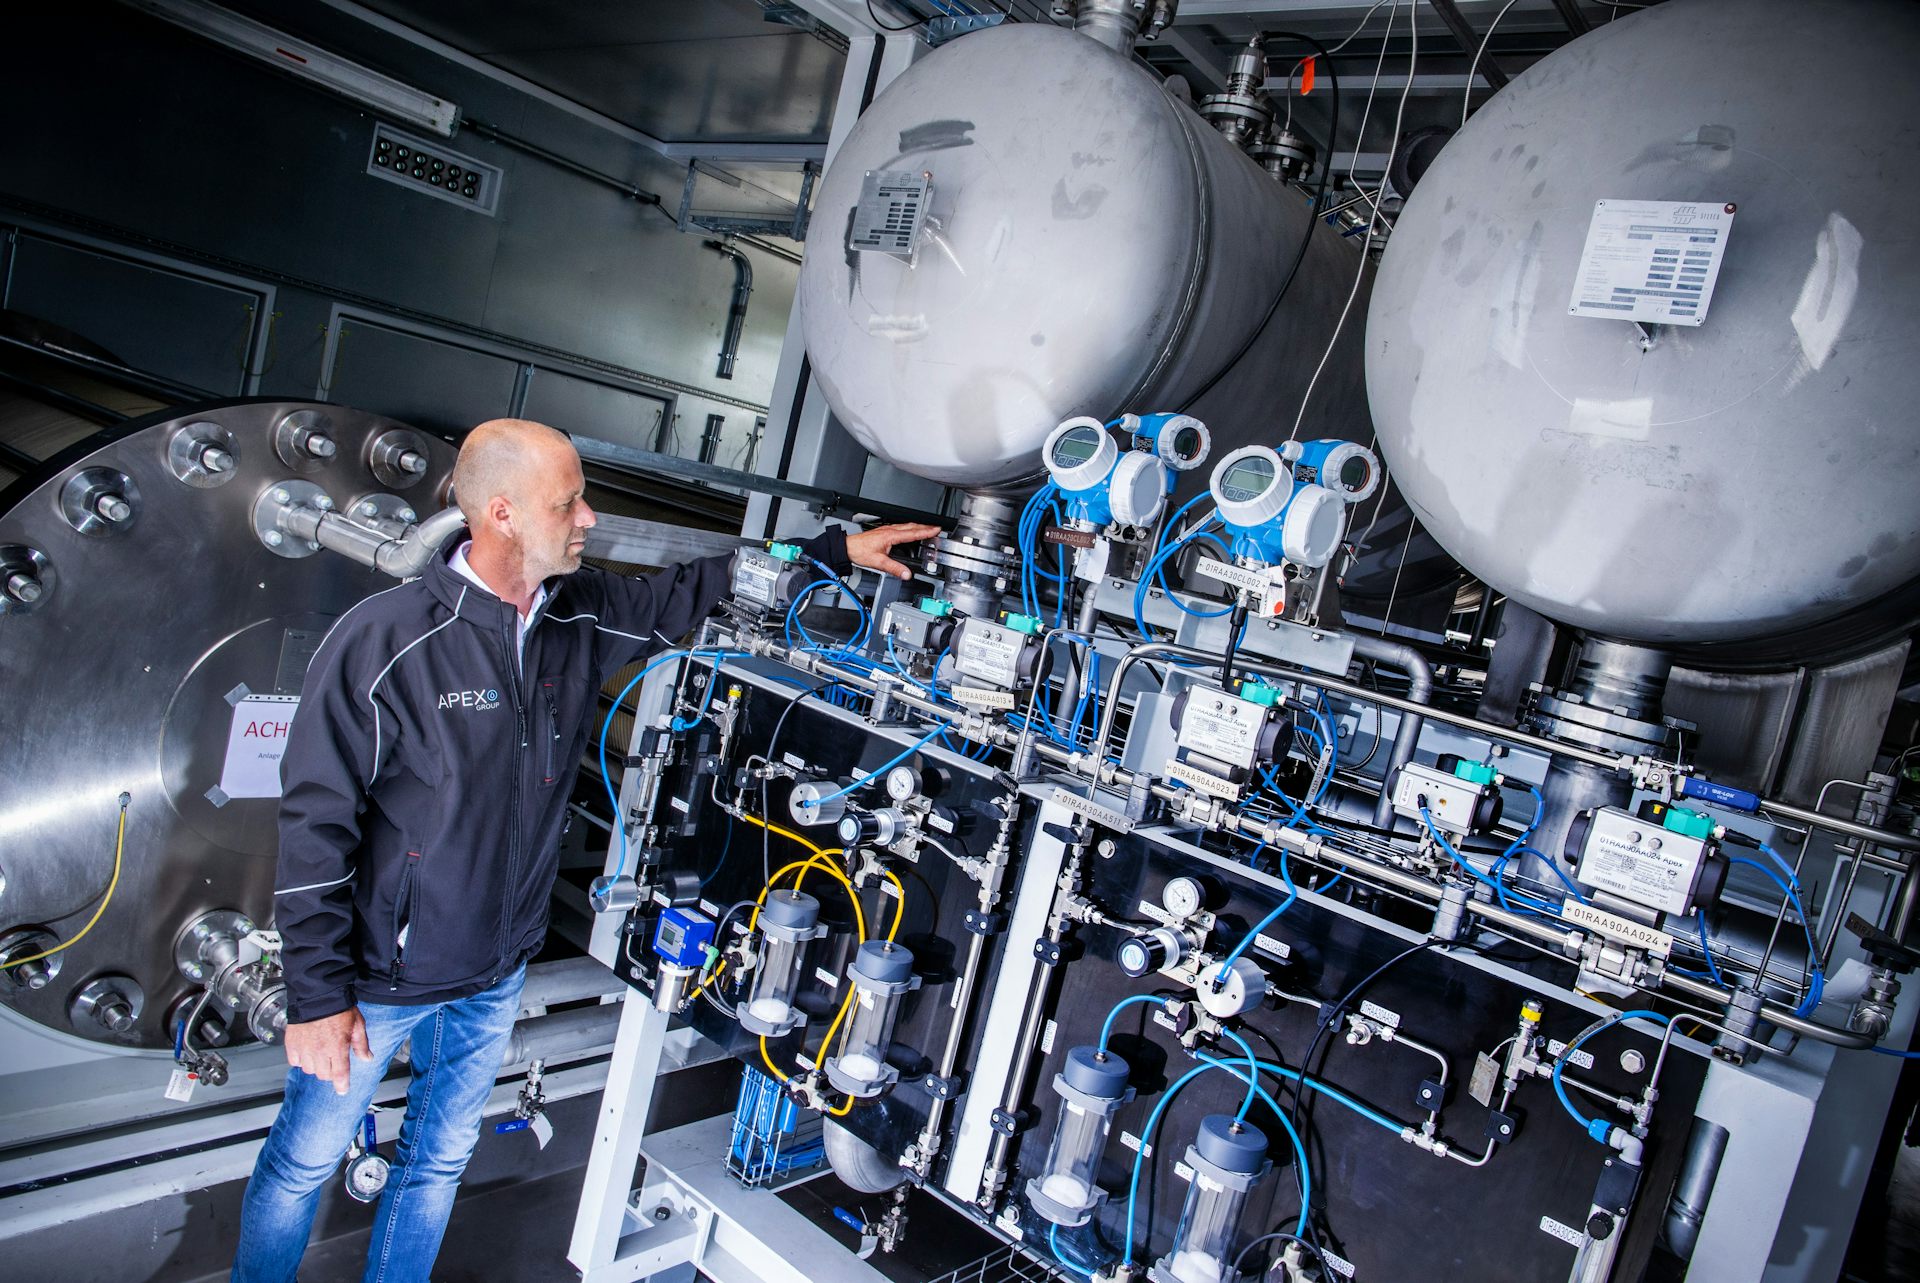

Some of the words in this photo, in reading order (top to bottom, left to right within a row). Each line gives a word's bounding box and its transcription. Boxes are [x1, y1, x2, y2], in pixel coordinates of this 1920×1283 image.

[1205, 563, 1261, 588] 01RAA30CL002
[438, 689, 487, 709] APEX
[476, 702, 500, 711] GROUP
[958, 690, 1007, 704] 01RAA90AA013
[244, 721, 293, 738] ACH
[1233, 719, 1248, 728] Apex
[258, 752, 281, 760] Anlage
[1172, 766, 1230, 795] 01RAA90AA023
[1062, 795, 1121, 826] 01RAA30AA511
[1600, 837, 1661, 861] 01RAA90AA024
[1663, 856, 1683, 868] Apex
[1574, 908, 1659, 946] 01RAA90AA024
